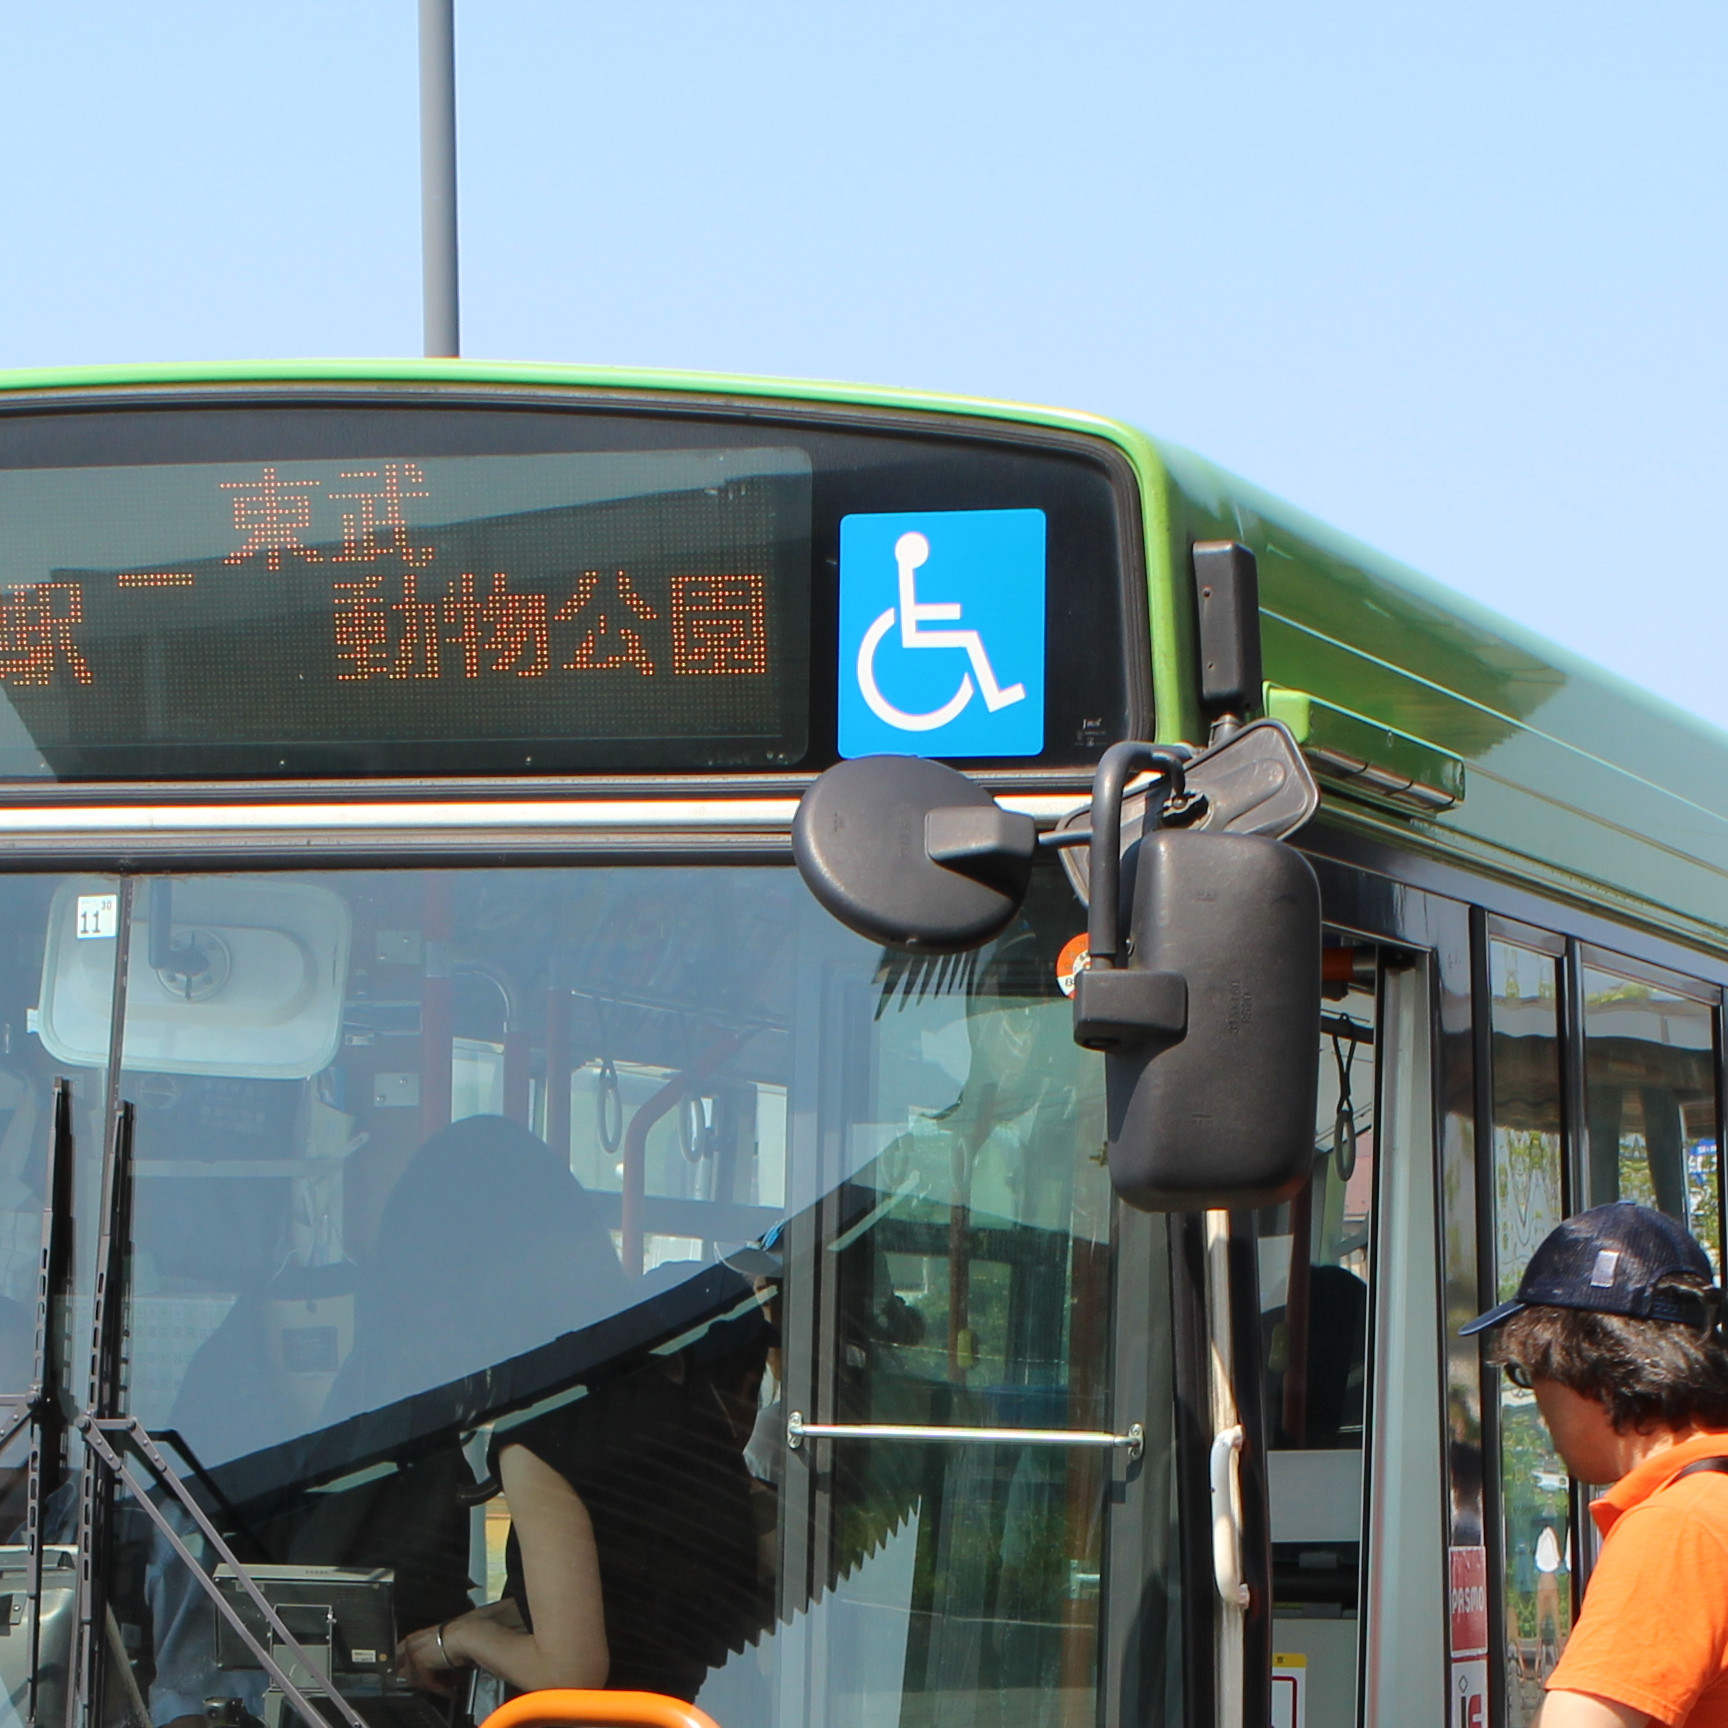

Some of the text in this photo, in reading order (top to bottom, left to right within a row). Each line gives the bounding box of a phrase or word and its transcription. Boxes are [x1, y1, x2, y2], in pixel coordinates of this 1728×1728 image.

[222, 463, 432, 566] 東武
[334, 570, 768, 680] 動物公園
[80, 910, 101, 934] 11
[1451, 1587, 1484, 1615] PASMO
